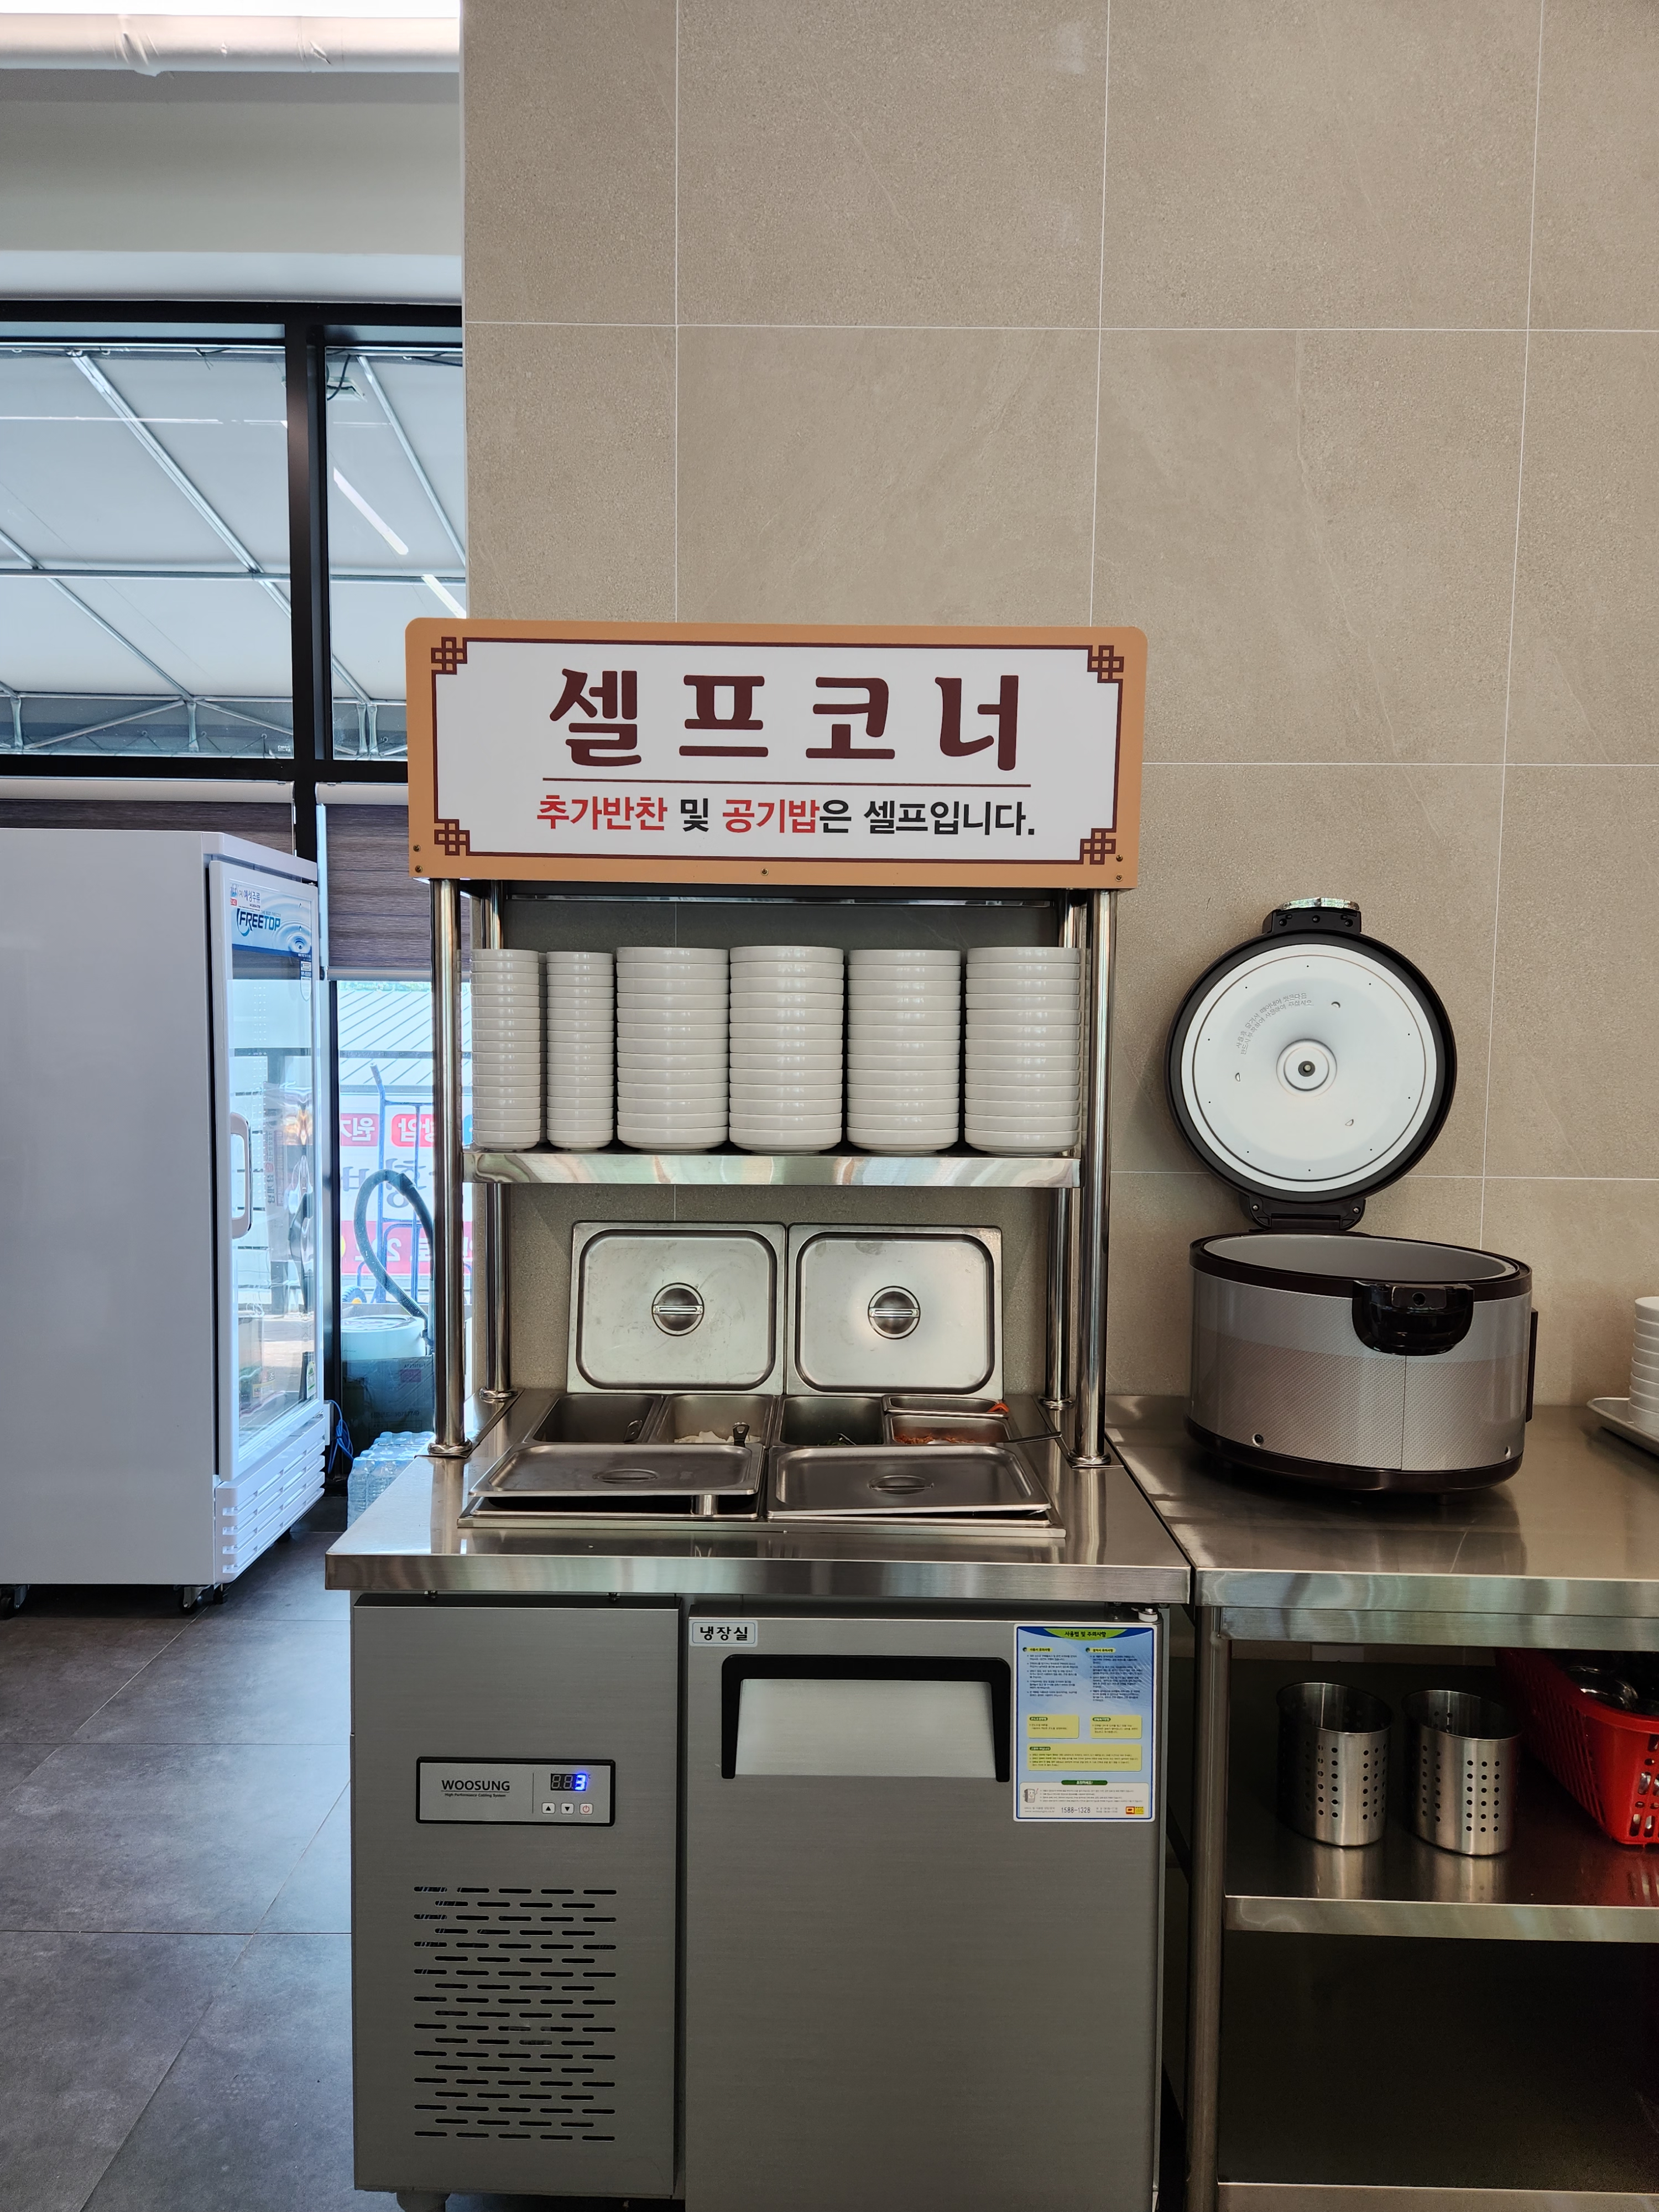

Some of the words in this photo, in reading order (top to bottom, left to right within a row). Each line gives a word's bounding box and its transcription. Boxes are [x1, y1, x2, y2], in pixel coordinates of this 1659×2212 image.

[549, 667, 1019, 771] 셀프코너
[537, 795, 668, 831] 추가반찬
[680, 798, 709, 832] 및
[722, 800, 852, 833] 공기밥은
[864, 800, 1035, 836] 셀프입니다.
[239, 911, 281, 931] FREETOP
[700, 1626, 748, 1641] 냉장실
[441, 1780, 510, 1791] WOOSUNG
